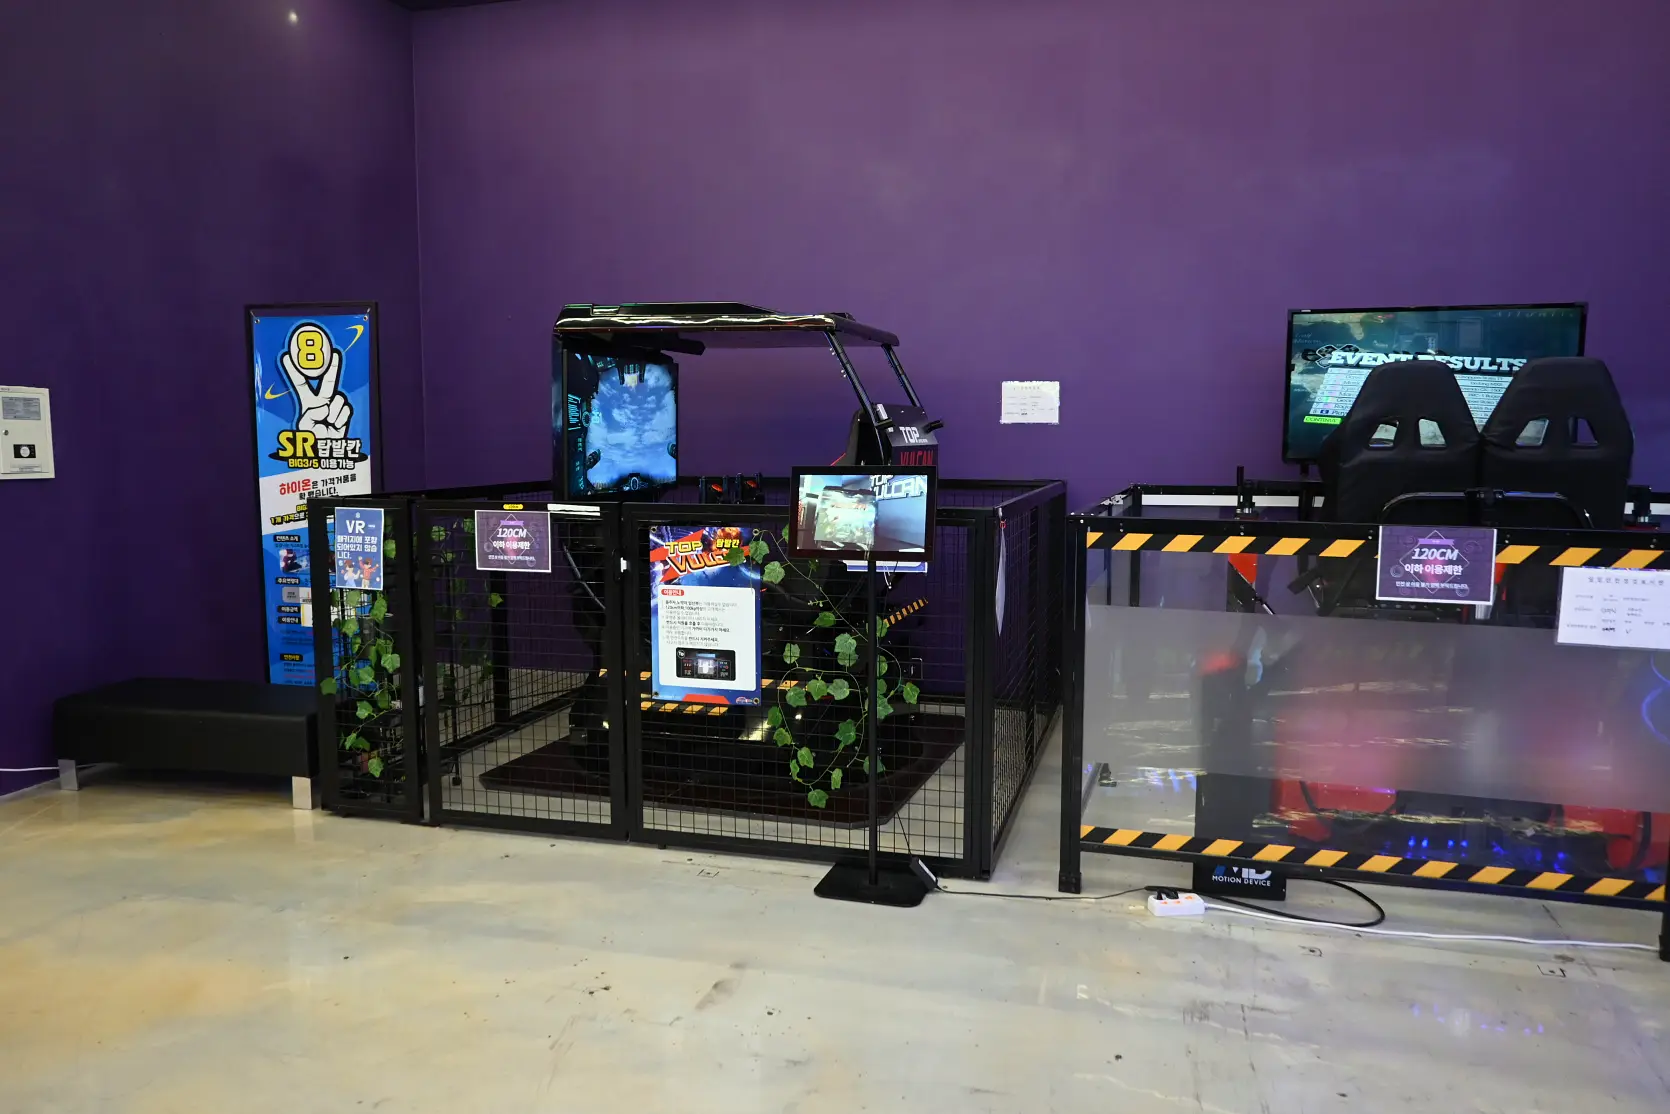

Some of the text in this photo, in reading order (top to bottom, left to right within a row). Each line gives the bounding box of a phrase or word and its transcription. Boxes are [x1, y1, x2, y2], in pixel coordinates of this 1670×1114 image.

[296, 331, 324, 369] 8
[1328, 350, 1527, 372] EVENT ESULTS
[899, 426, 920, 443] TOP
[288, 458, 319, 468] BIG3/5
[345, 519, 366, 534] VR
[496, 528, 527, 538] 120CM
[364, 536, 378, 545] 포함
[492, 541, 531, 550] 이하 이용제한
[336, 543, 377, 553] 되어있지 않습
[665, 540, 703, 555] TOP
[337, 551, 352, 559] 니다.
[1412, 547, 1459, 561] 120CM
[1404, 563, 1463, 575] 이하 이용제한
[1212, 875, 1271, 887] MOTION DEVICE
